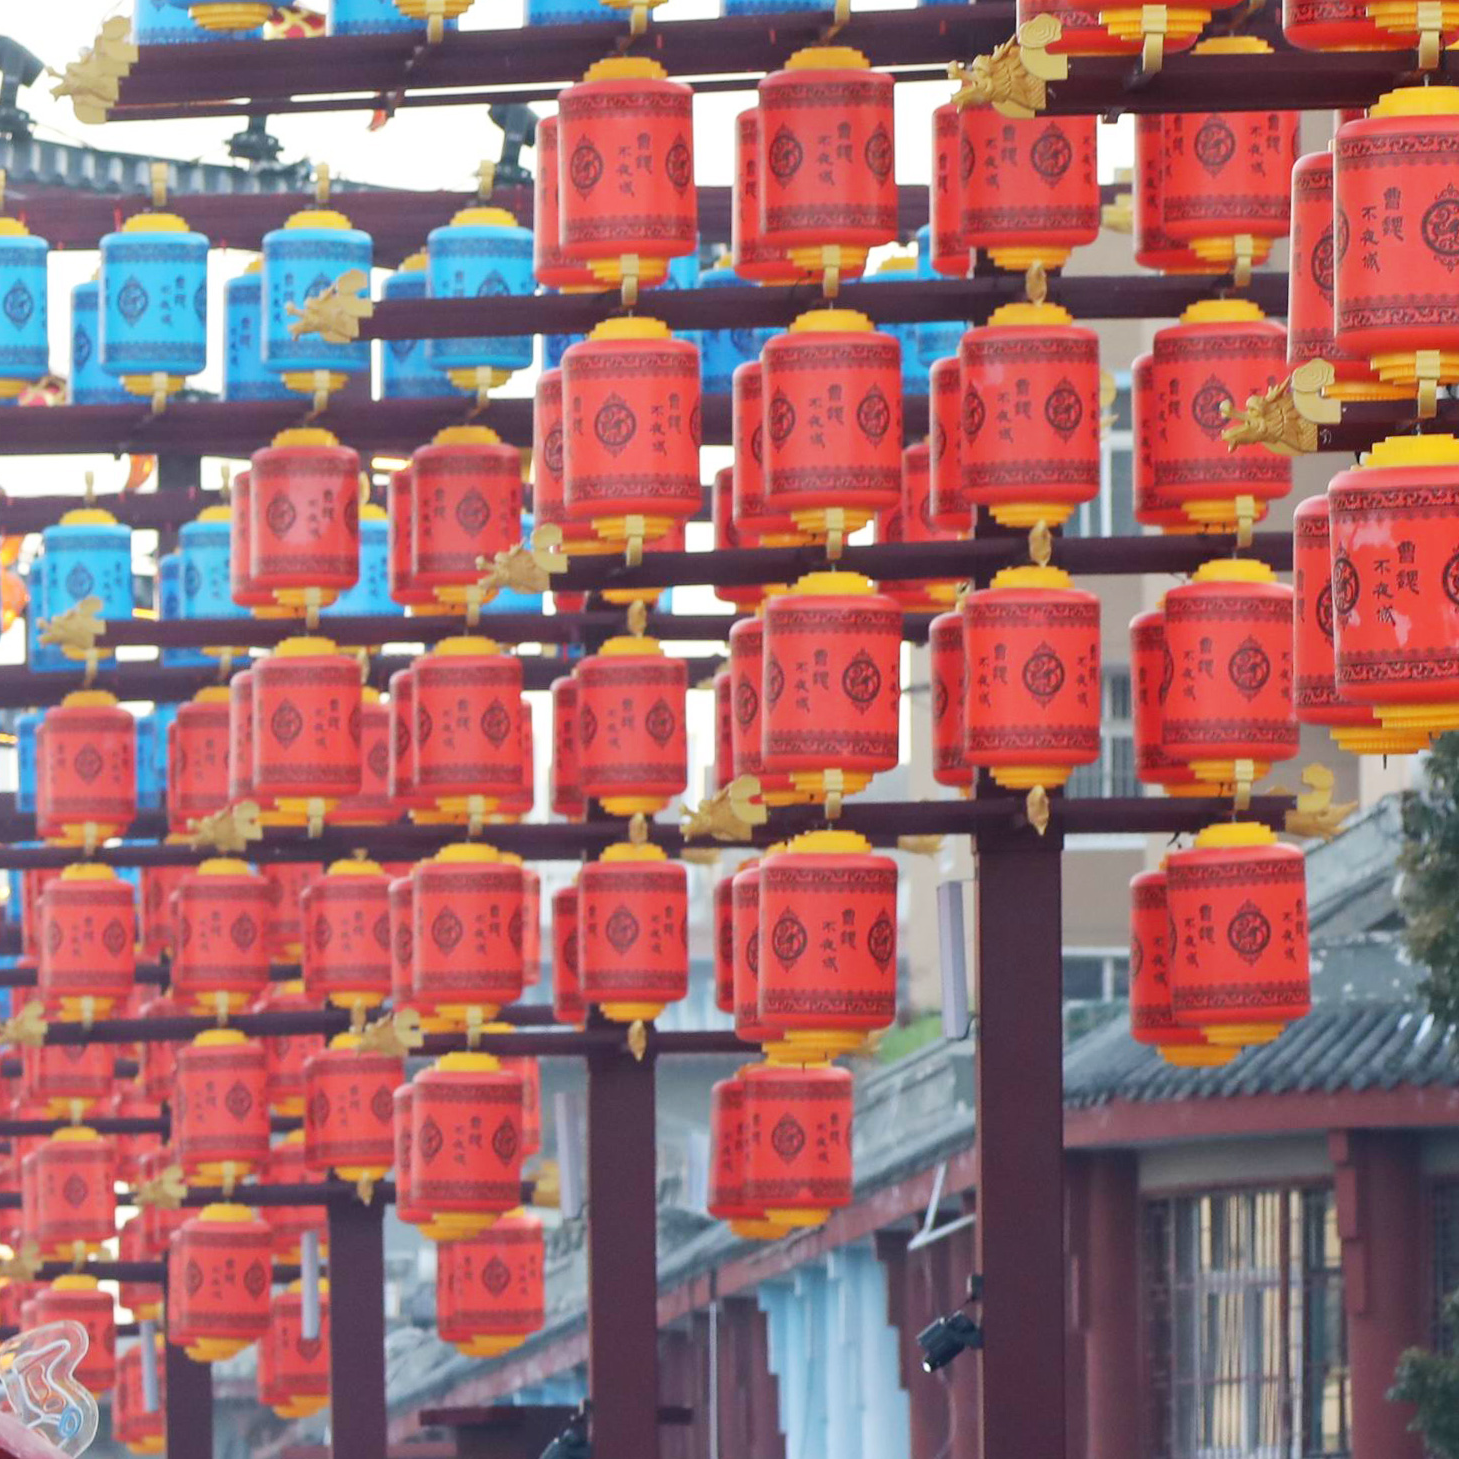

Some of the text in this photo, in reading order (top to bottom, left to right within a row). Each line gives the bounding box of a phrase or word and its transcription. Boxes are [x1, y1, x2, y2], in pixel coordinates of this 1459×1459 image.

[1361, 206, 1379, 272] 不夜城
[1382, 187, 1403, 241] 曹魏
[1373, 559, 1396, 625] 不夜城
[1397, 540, 1419, 595] 曹魏
